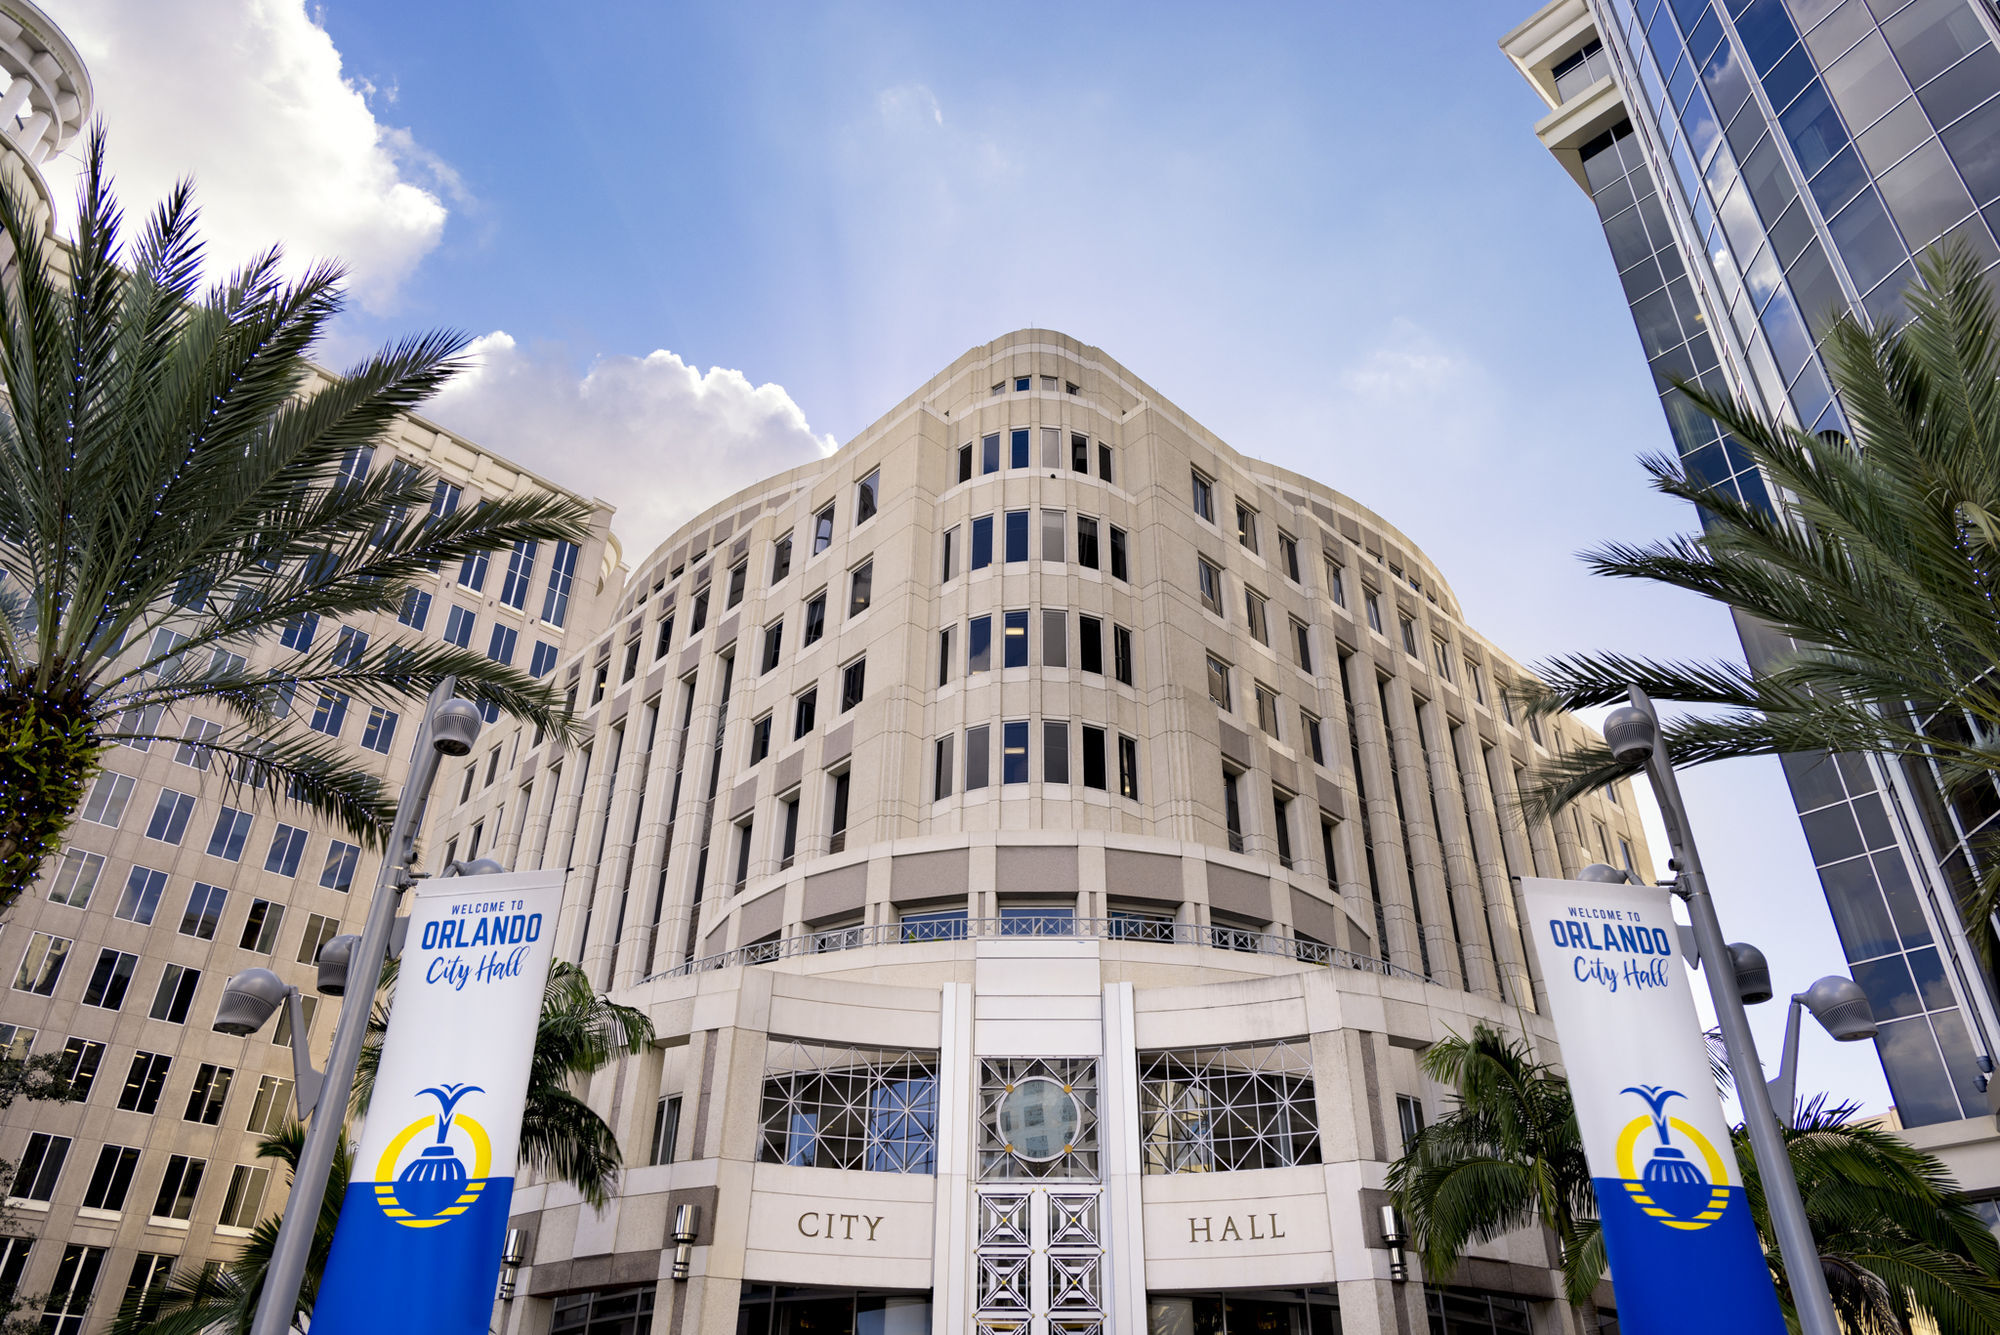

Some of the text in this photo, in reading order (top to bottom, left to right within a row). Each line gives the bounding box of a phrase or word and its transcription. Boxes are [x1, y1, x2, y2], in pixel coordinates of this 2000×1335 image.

[451, 900, 524, 915] WELCOME TO
[1568, 906, 1641, 922] WELCOME TO
[421, 913, 543, 950] ORLANDO
[1549, 919, 1671, 956] ORLANDO
[426, 945, 531, 991] City Hall
[1574, 955, 1669, 993] City Hall
[797, 1212, 1286, 1243] CITY HALL
